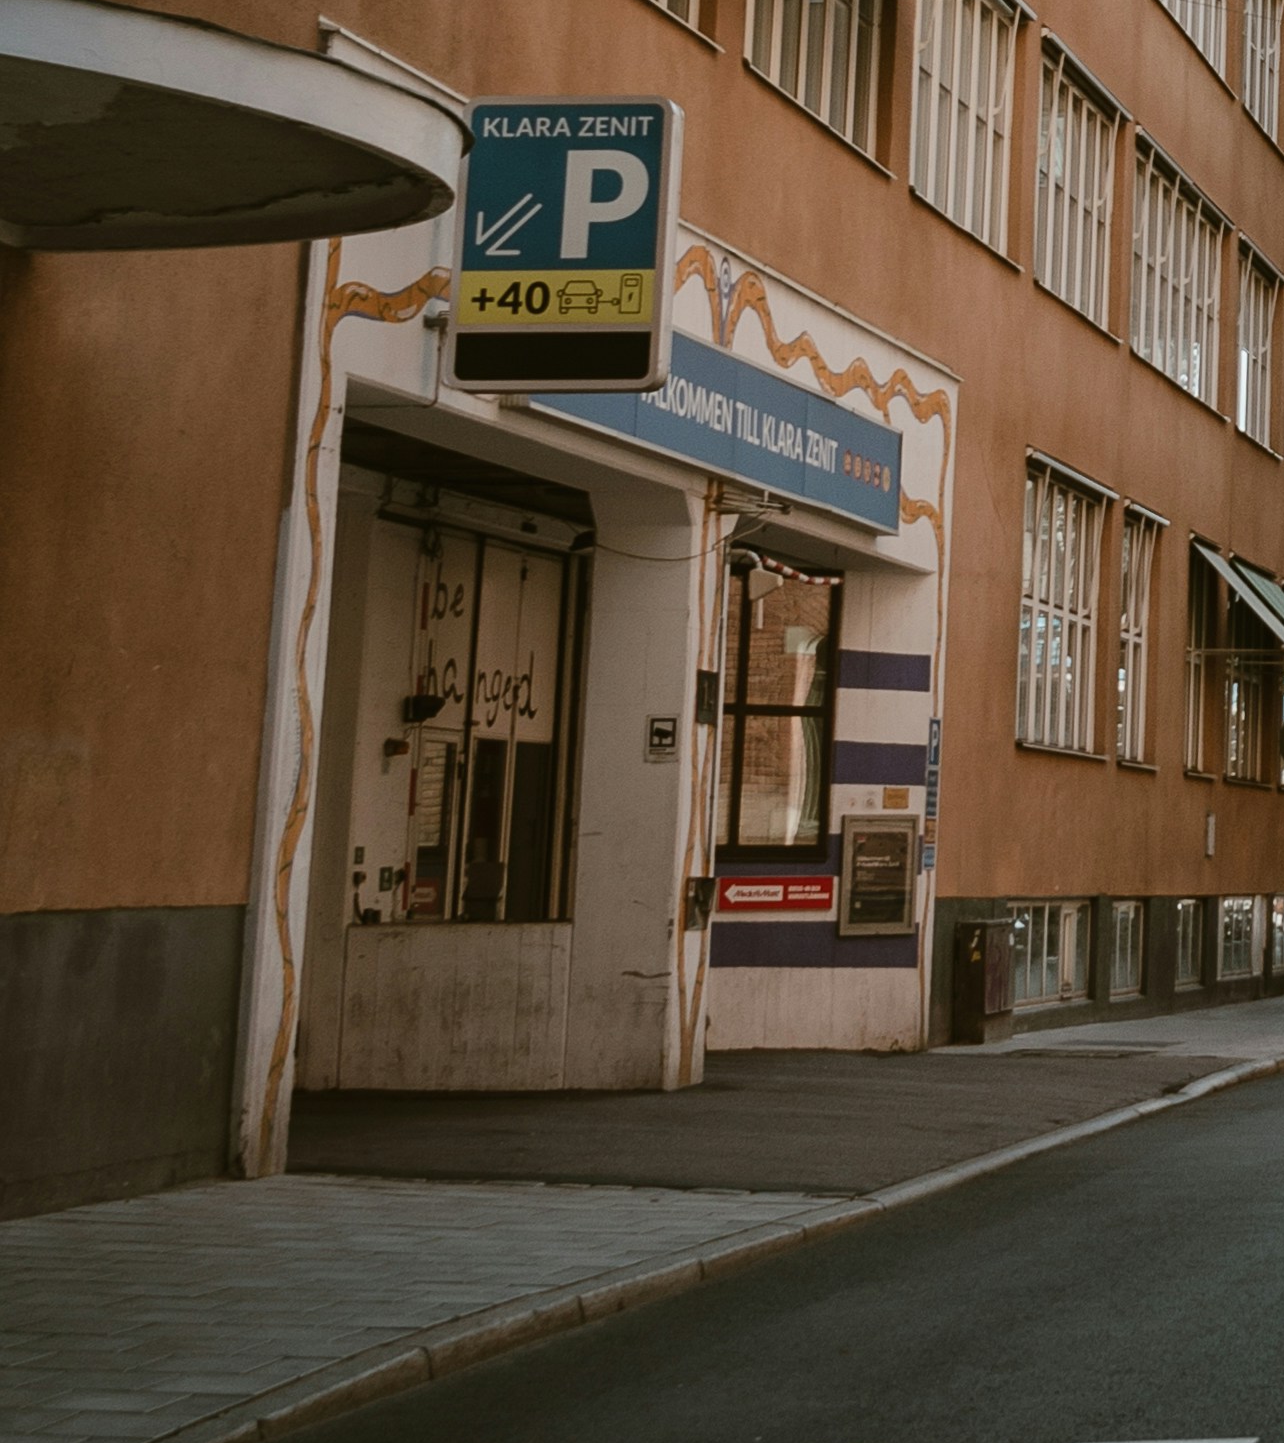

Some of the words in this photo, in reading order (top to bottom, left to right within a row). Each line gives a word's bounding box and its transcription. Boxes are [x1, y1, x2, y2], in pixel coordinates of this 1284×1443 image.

[482, 116, 571, 138] KLARA
[578, 116, 653, 137] ZENIT
[560, 149, 649, 259] P
[471, 281, 550, 315] +40
[735, 401, 760, 446] TILL
[762, 413, 803, 462] KLARA
[805, 428, 838, 474] ZENIT
[930, 723, 939, 762] P
